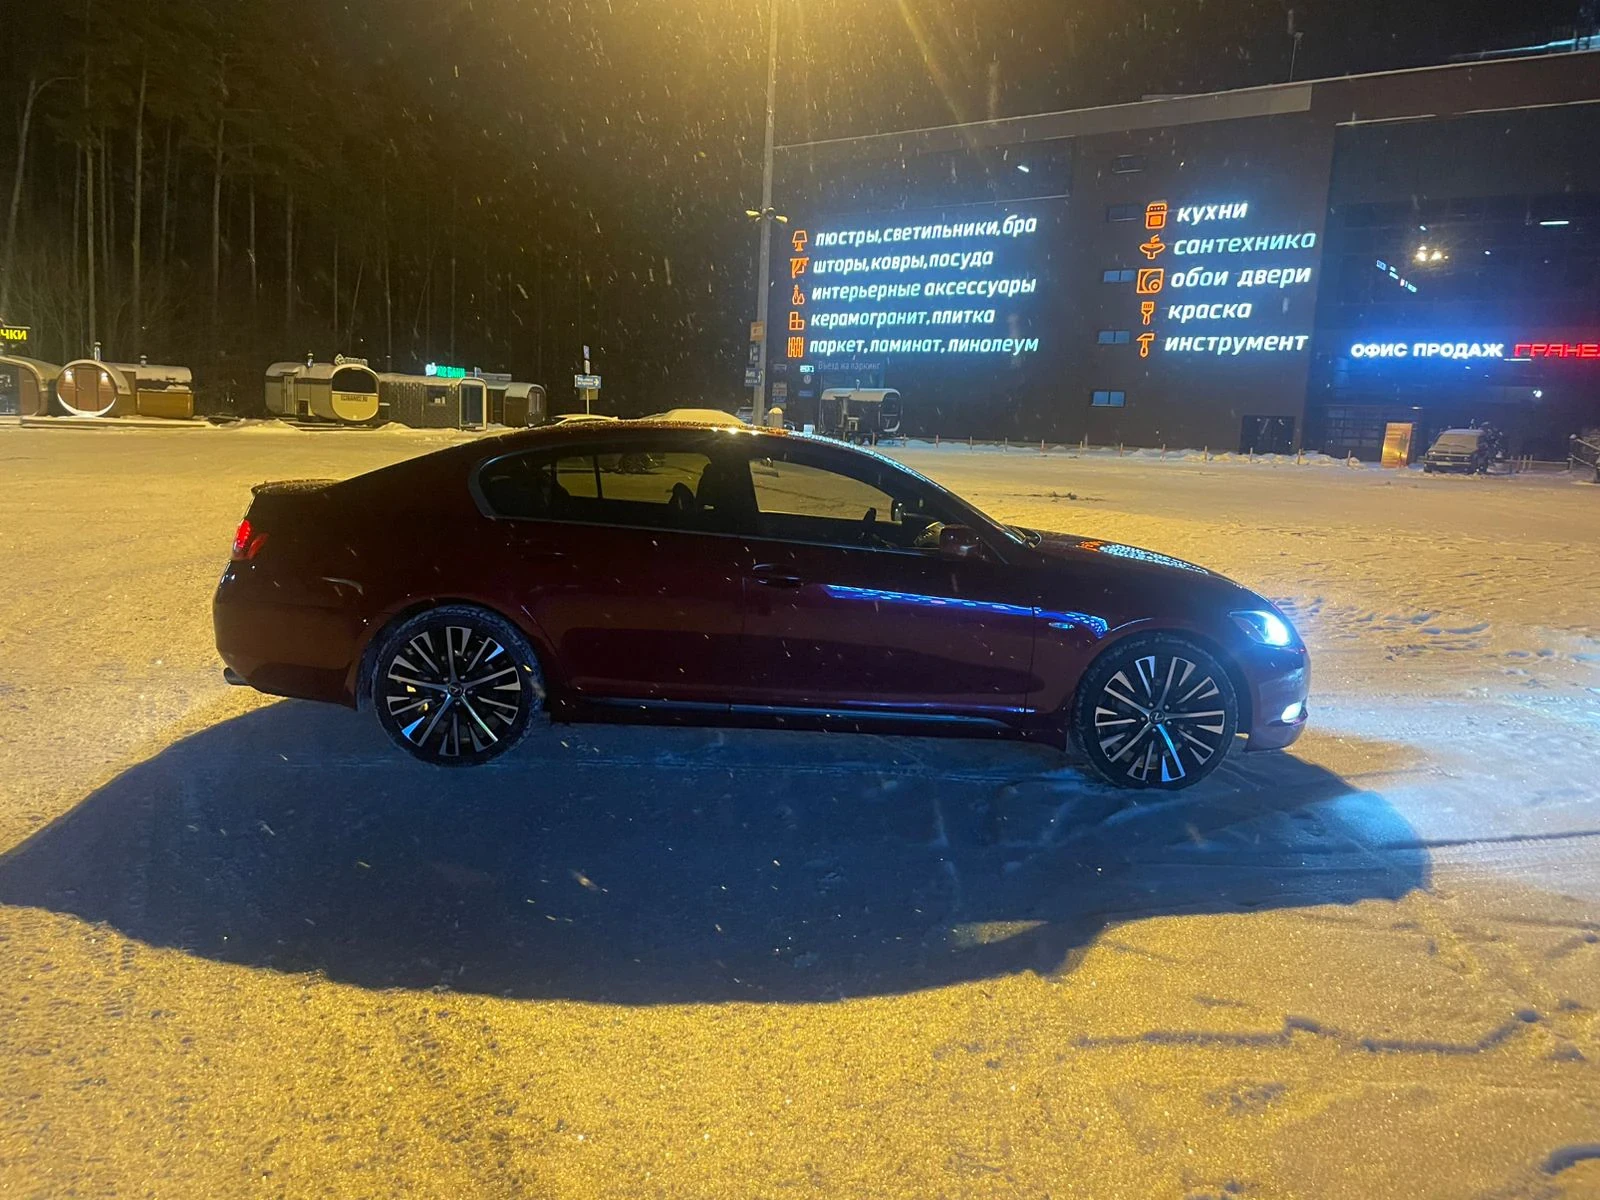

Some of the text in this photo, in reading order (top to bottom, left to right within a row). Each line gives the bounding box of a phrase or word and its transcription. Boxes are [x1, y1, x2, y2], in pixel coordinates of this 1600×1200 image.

[1176, 202, 1249, 226] кухни
[1173, 232, 1317, 256] сантехника
[1170, 266, 1312, 289] обои двери
[811, 277, 1037, 303] интерьерные аксессуары
[1167, 302, 1253, 324] краска
[1164, 335, 1309, 356] инструмент
[1350, 342, 1600, 360] ОФИС ПРОДАЖ ГРАНЕ
